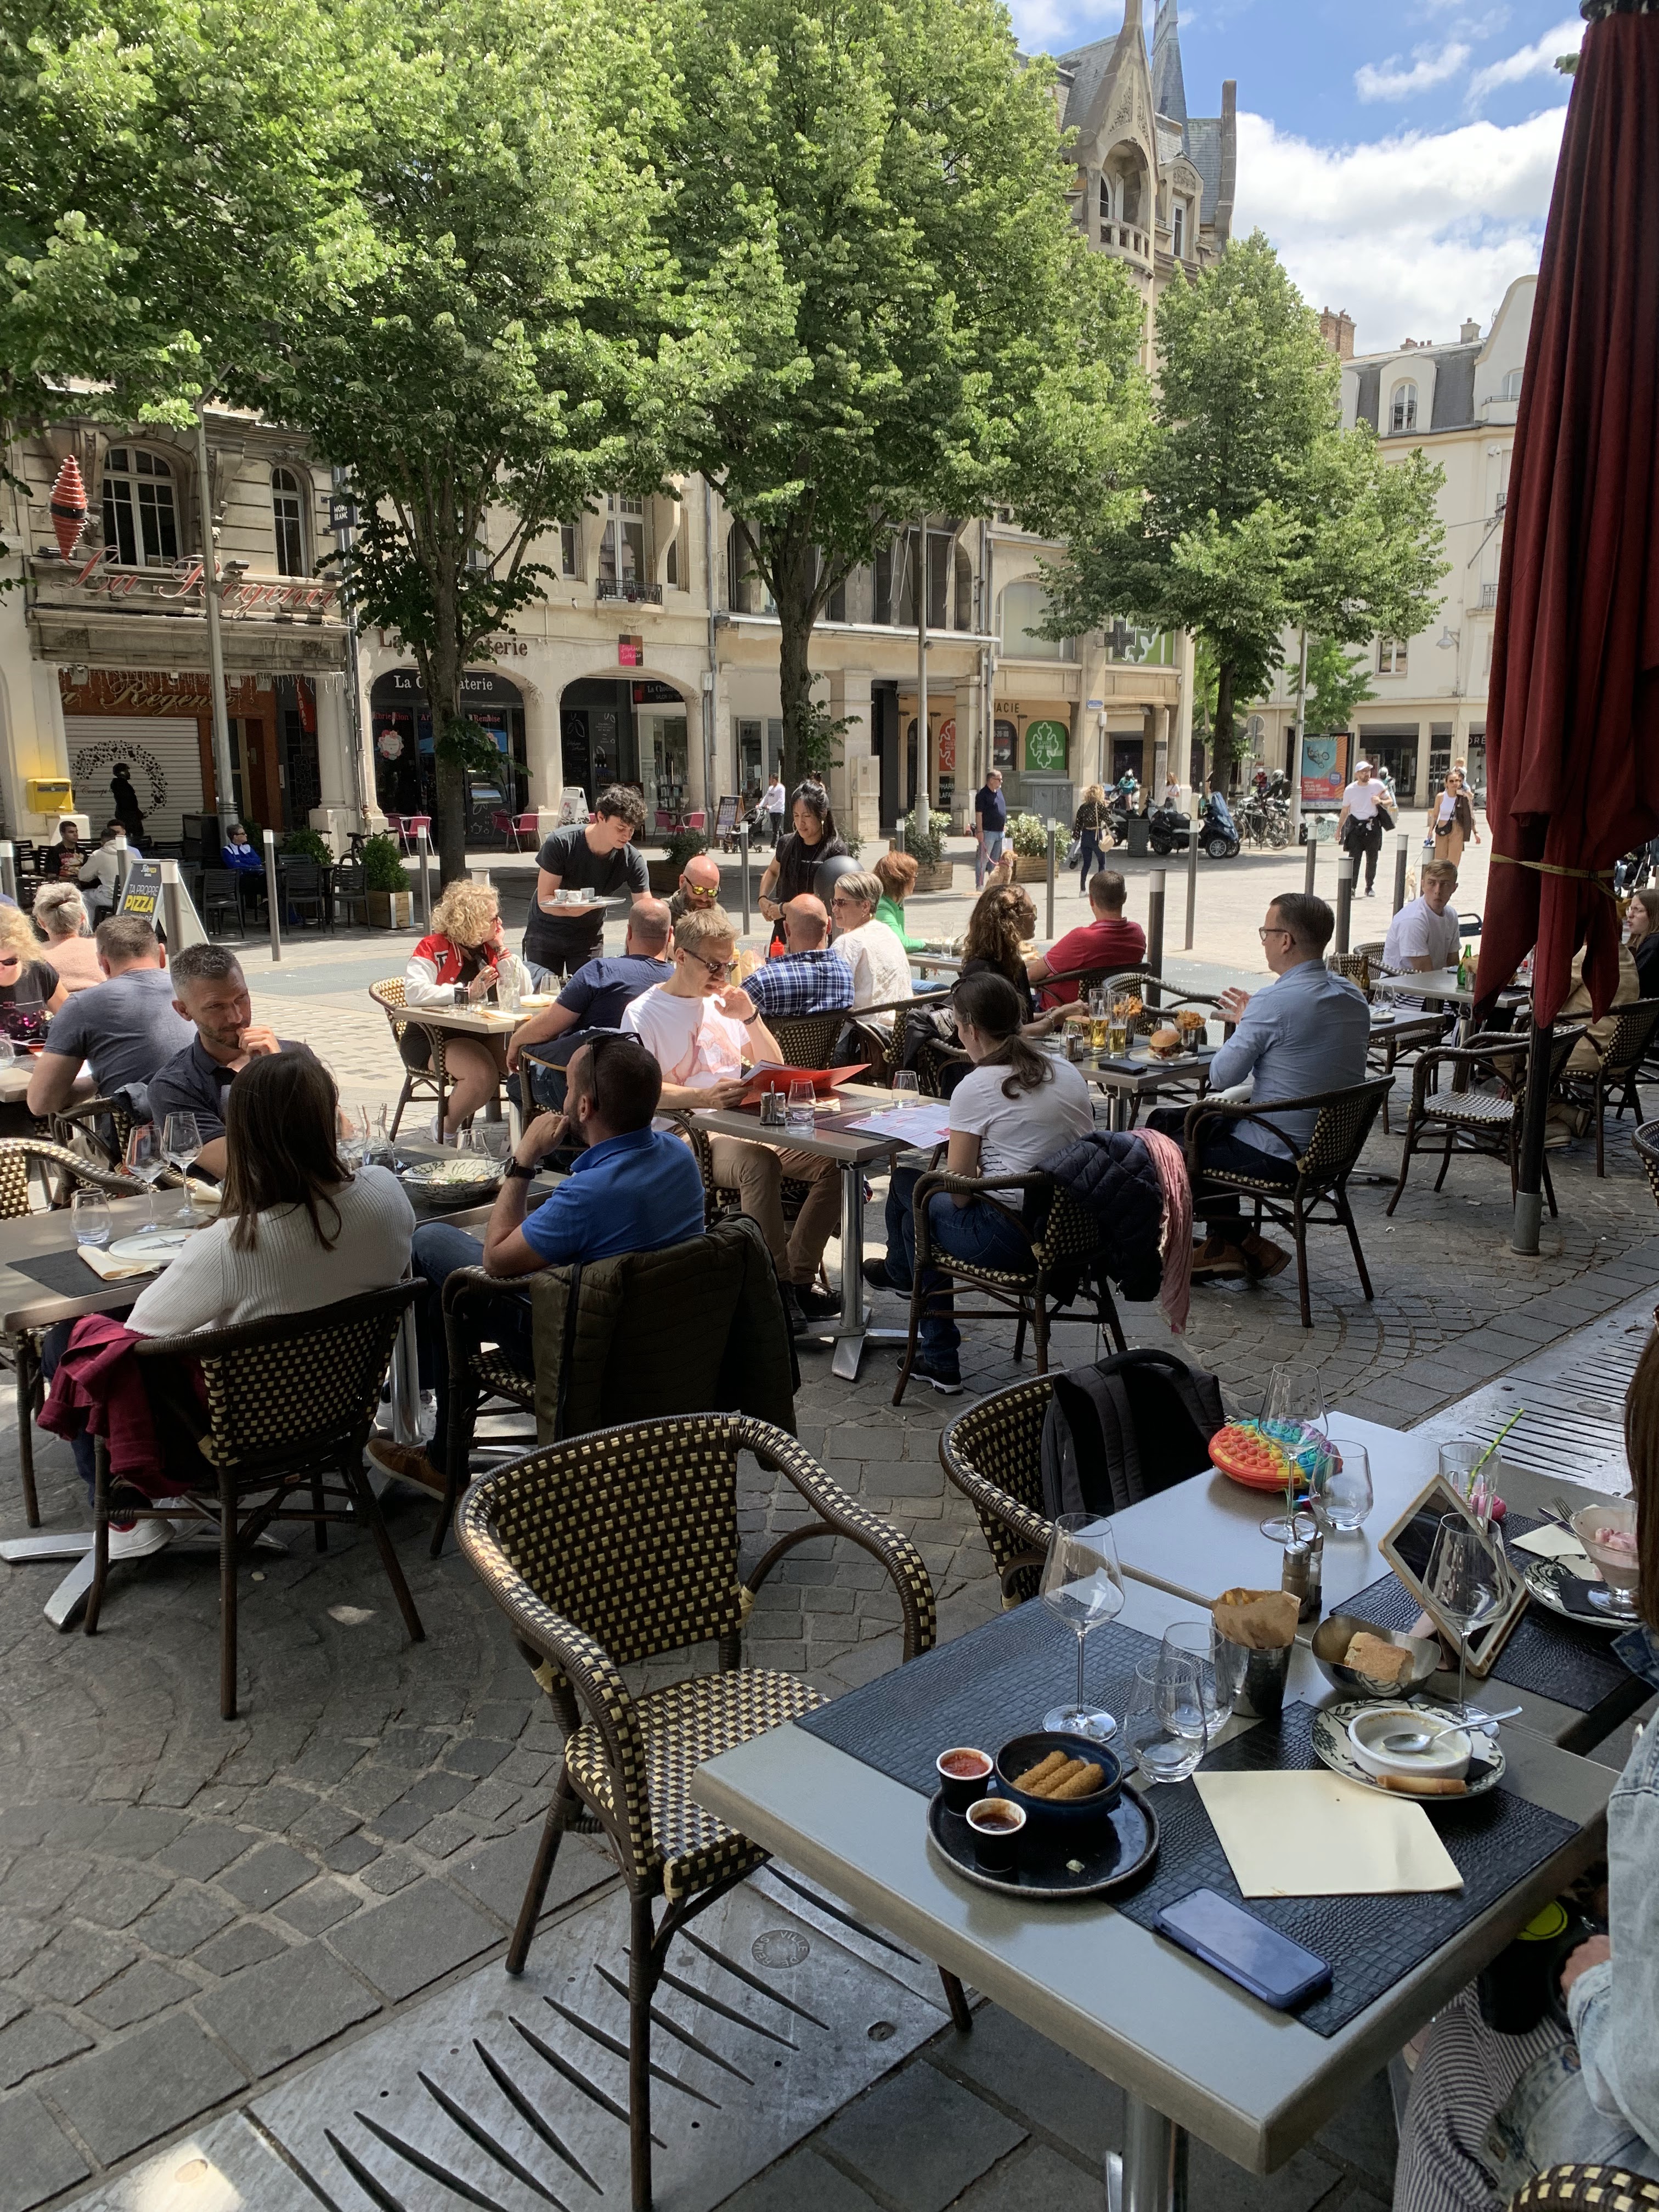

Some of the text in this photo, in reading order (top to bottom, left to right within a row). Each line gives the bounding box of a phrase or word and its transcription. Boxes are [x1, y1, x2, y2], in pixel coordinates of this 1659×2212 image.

[334, 511, 348, 521] BLANC
[51, 545, 142, 595] La
[393, 675, 411, 689] La
[128, 884, 159, 896] TA PROPRE
[123, 894, 154, 913] PIZZA
[754, 1931, 808, 1967] VILLE DE REIMS
